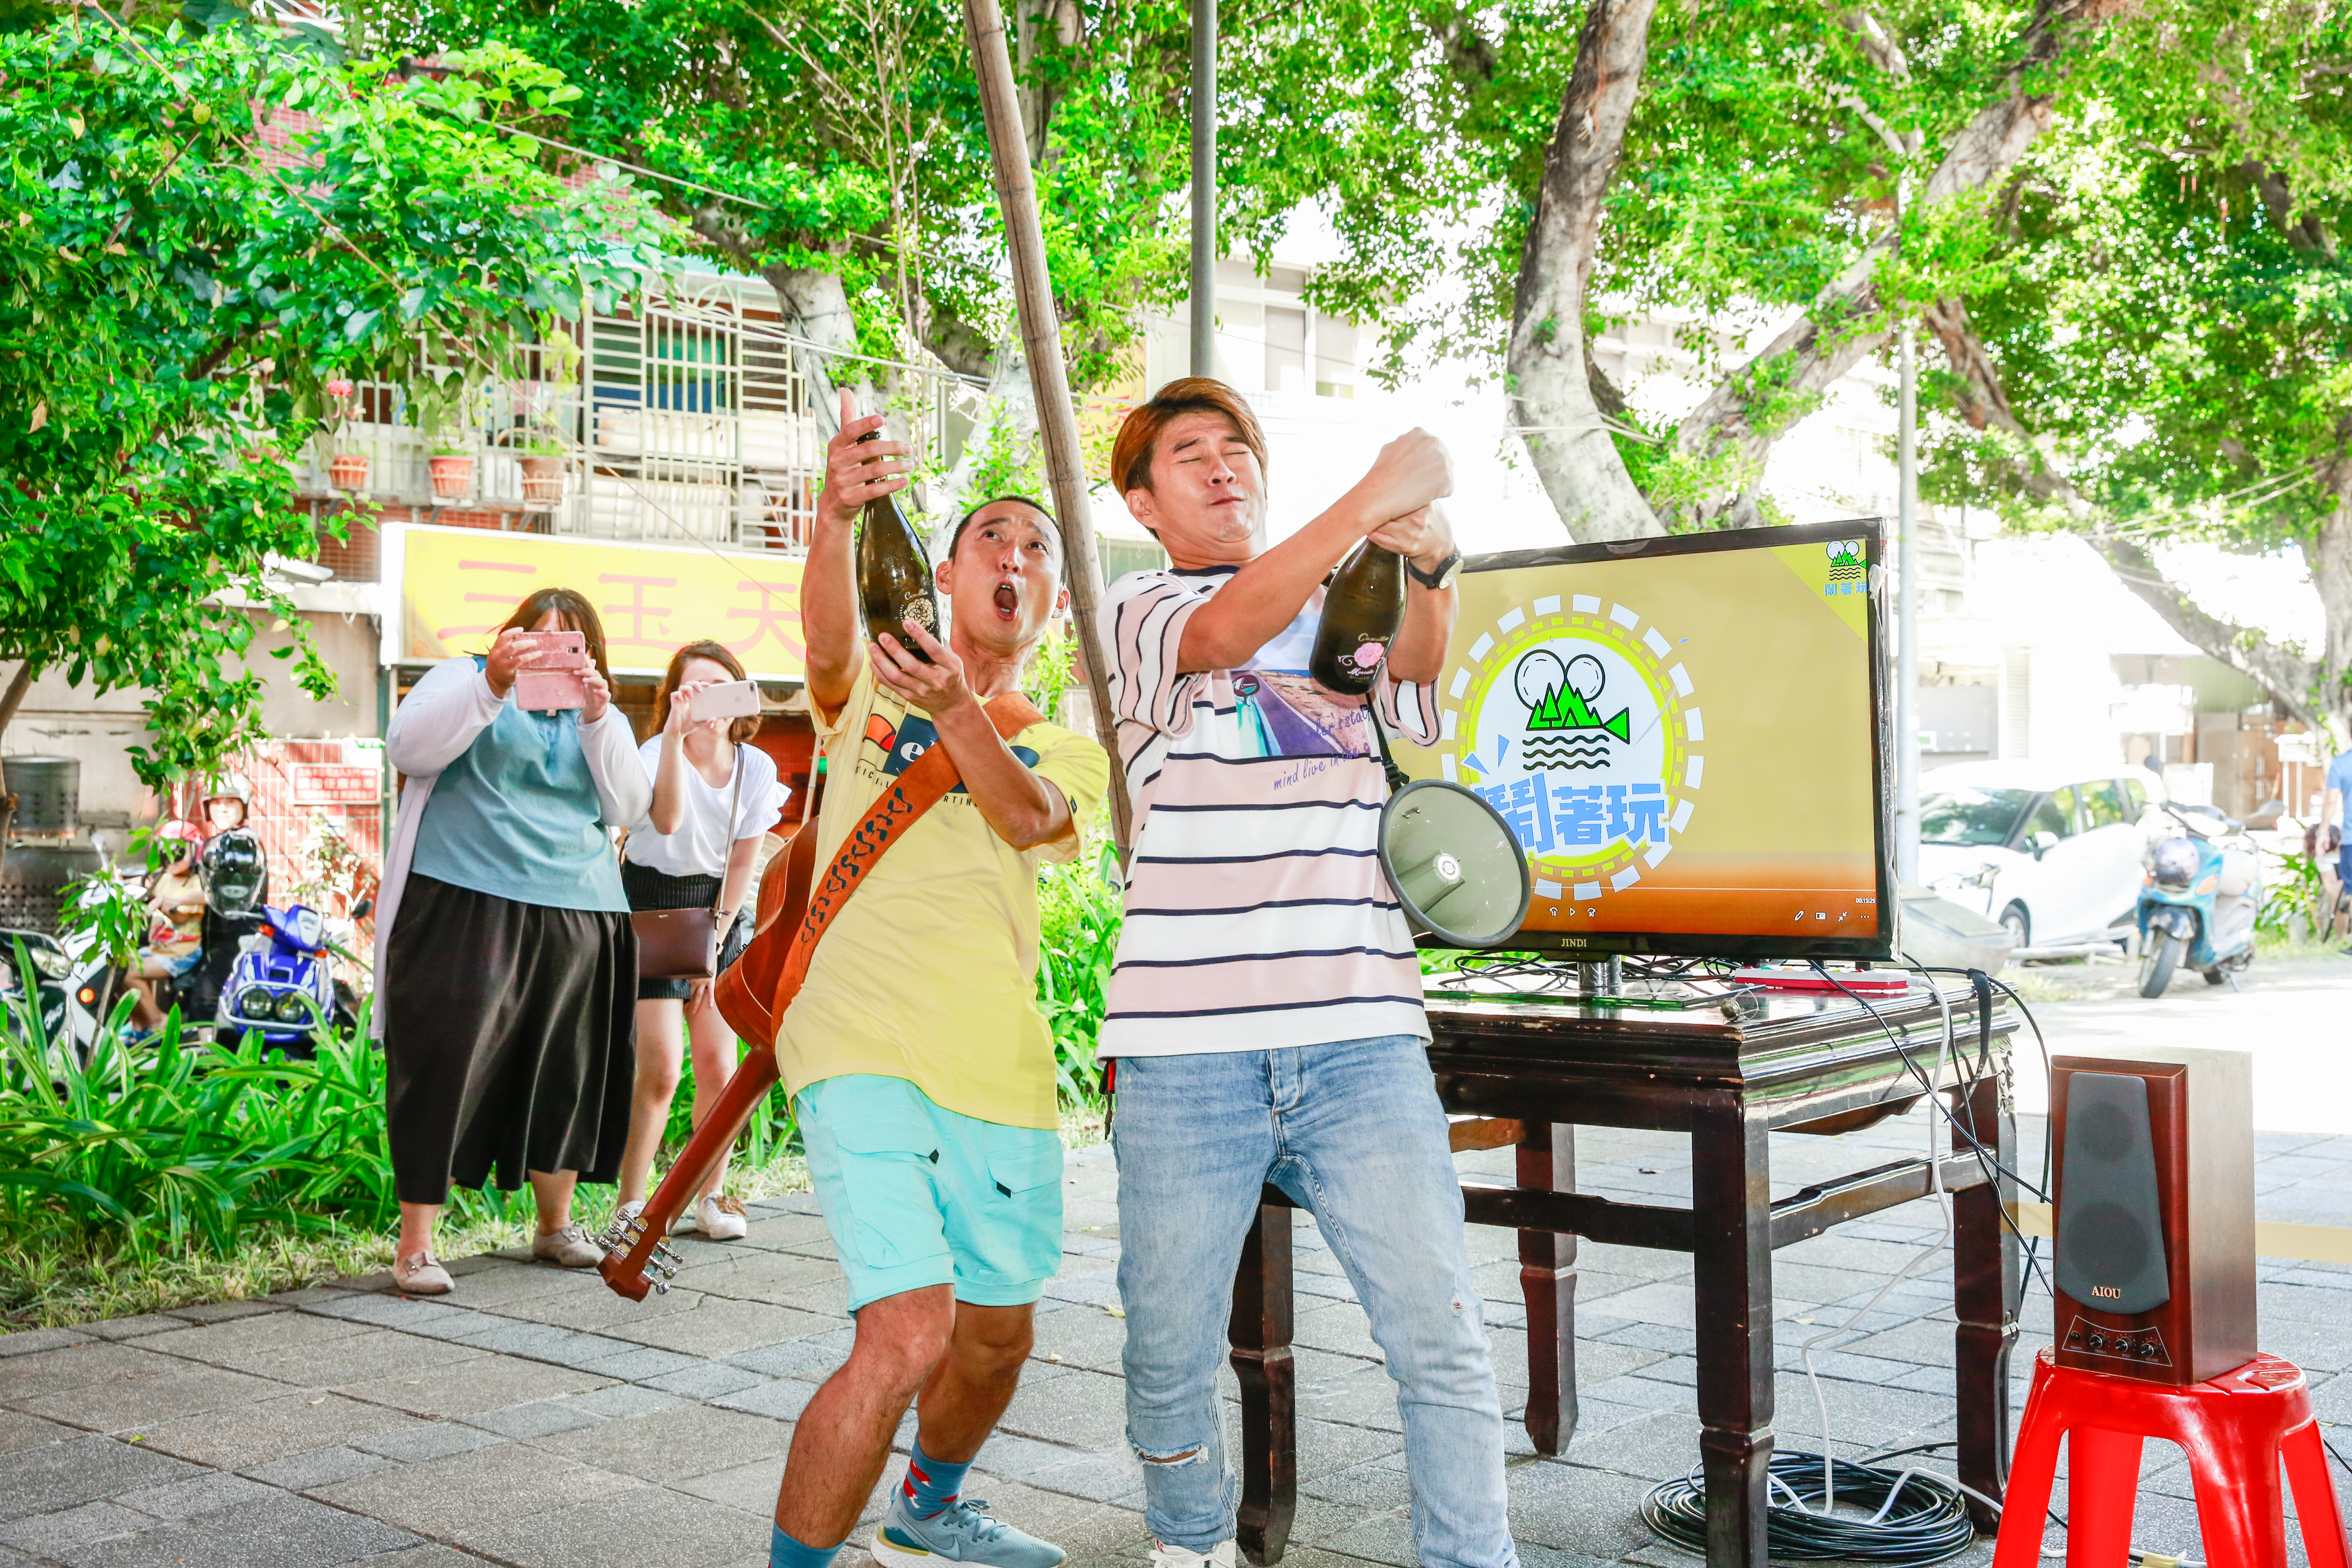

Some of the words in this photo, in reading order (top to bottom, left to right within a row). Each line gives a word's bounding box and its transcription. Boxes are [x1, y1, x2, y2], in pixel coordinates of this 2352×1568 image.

[1274, 762, 1299, 791] mind
[1303, 758, 1326, 779] live
[1474, 772, 1665, 853] 鬧著玩
[1561, 938, 1587, 947] JINDI
[2091, 1285, 2121, 1299] AIOU
